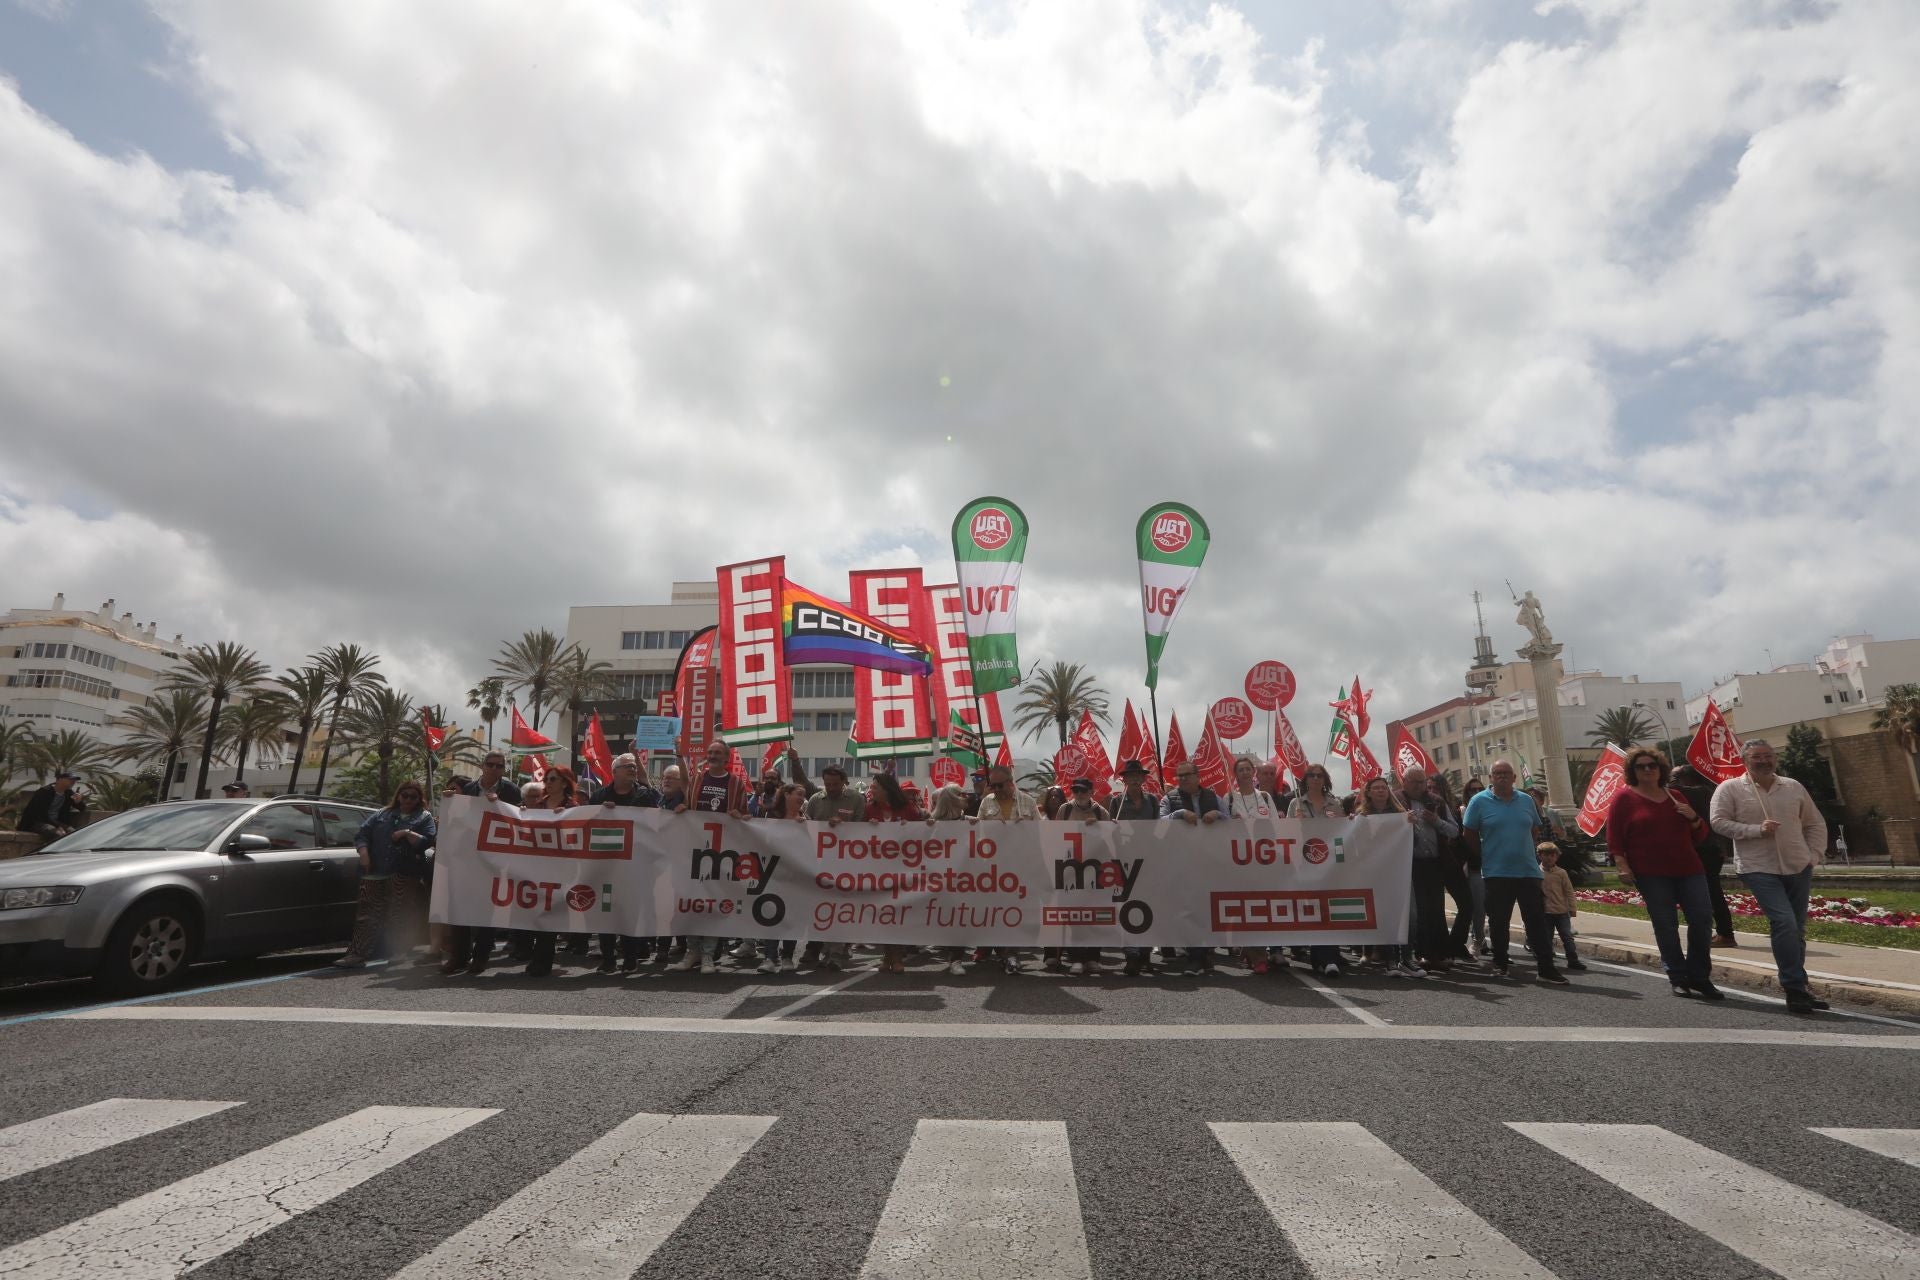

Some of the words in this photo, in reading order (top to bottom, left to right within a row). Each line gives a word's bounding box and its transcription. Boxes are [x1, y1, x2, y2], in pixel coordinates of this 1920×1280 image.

[976, 515, 1007, 532] UGT
[1156, 518, 1187, 536] UGT
[965, 584, 1016, 616] UGT
[798, 608, 884, 645] CCOO
[731, 561, 778, 728] CCOO
[1253, 665, 1288, 682] UGT
[690, 668, 707, 732] CCOO
[1215, 701, 1245, 717] UGT
[1586, 768, 1615, 805] UGT
[486, 821, 584, 850] CCOO
[817, 832, 957, 868] Proteger
[969, 830, 997, 859] lo
[1231, 838, 1297, 865] UGT
[490, 877, 562, 912] UGT
[815, 864, 1027, 899] conquistado,
[678, 898, 716, 914] UGT
[813, 901, 912, 932] ganar
[925, 898, 1023, 928] futuro
[1046, 910, 1093, 922] CCOO
[1218, 898, 1322, 924] CCOO
